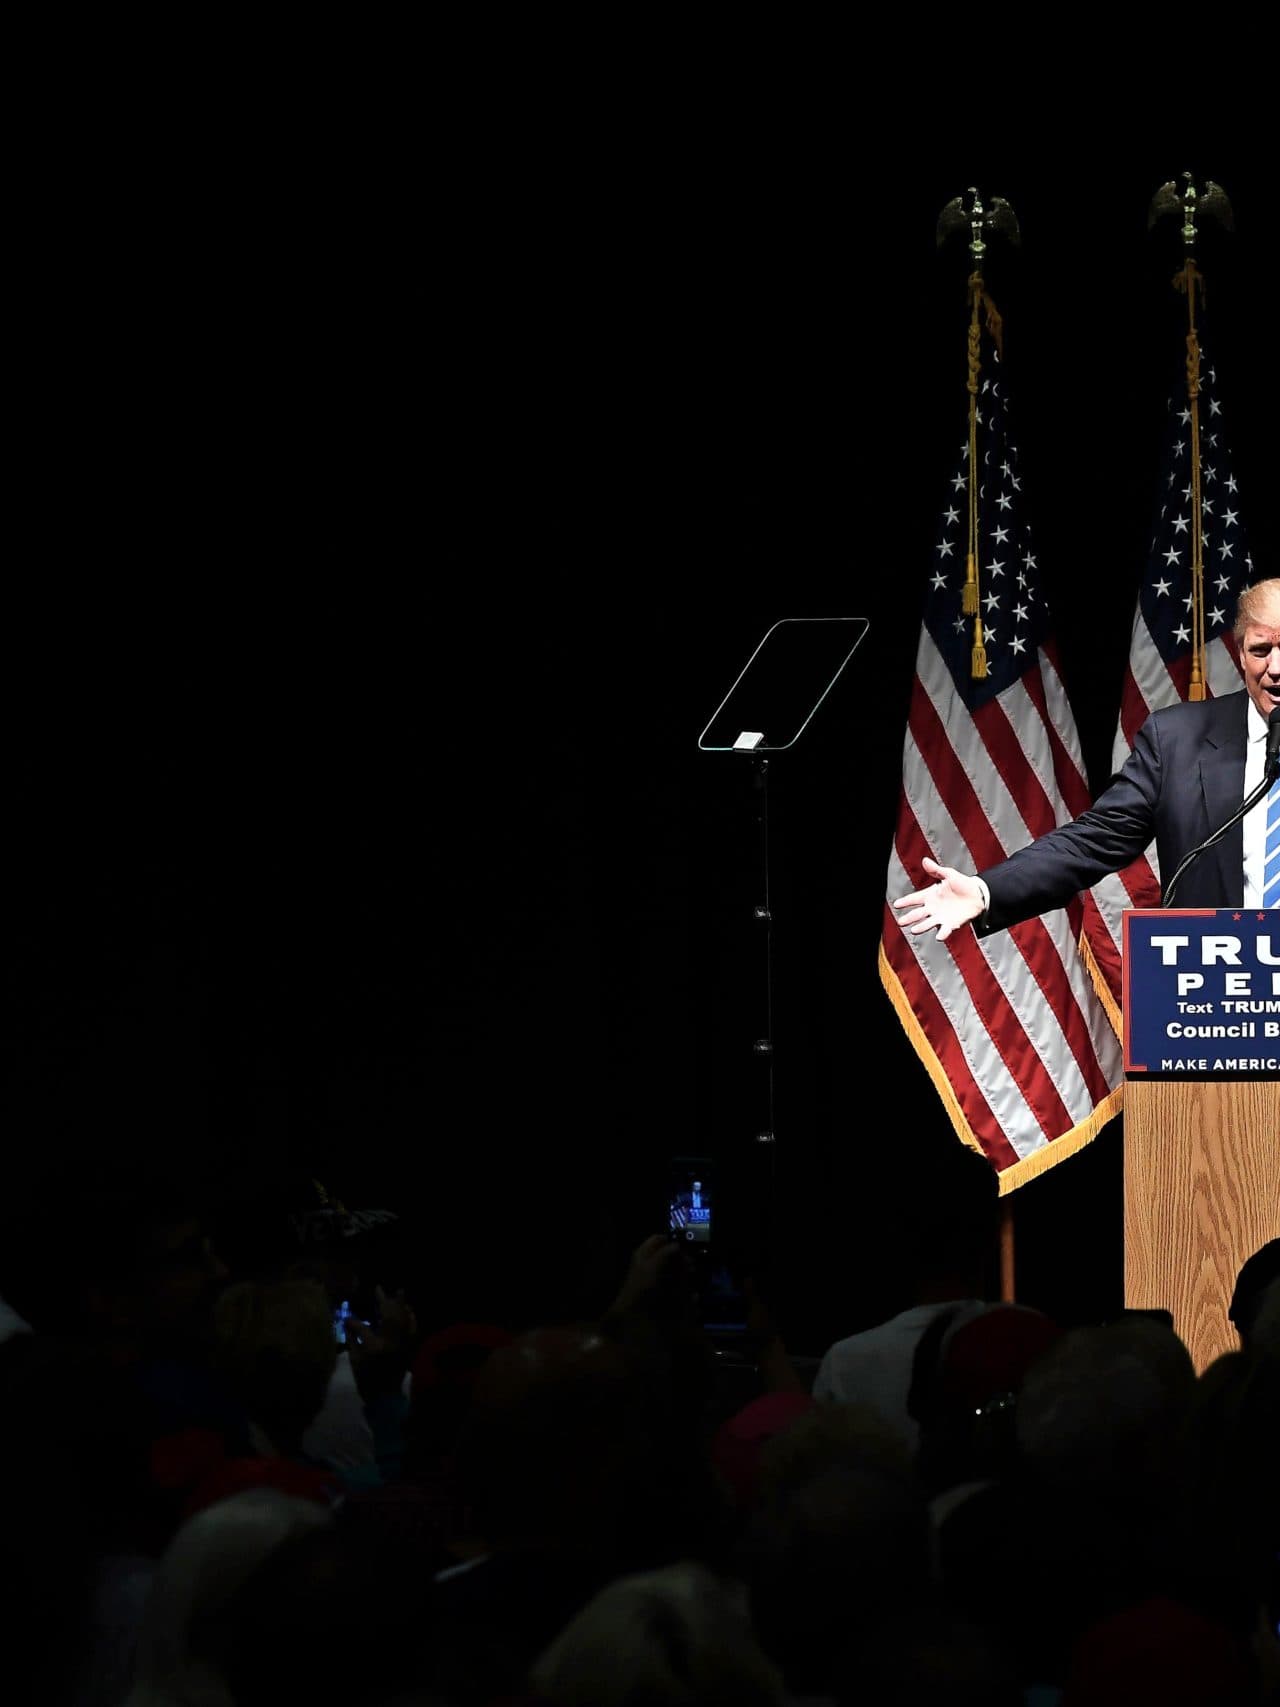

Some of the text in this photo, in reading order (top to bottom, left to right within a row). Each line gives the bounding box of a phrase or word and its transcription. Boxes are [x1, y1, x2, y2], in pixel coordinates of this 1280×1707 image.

[1176, 1001, 1214, 1014] Text
[1166, 1021, 1256, 1039] Council
[1161, 1059, 1208, 1071] MAKE
